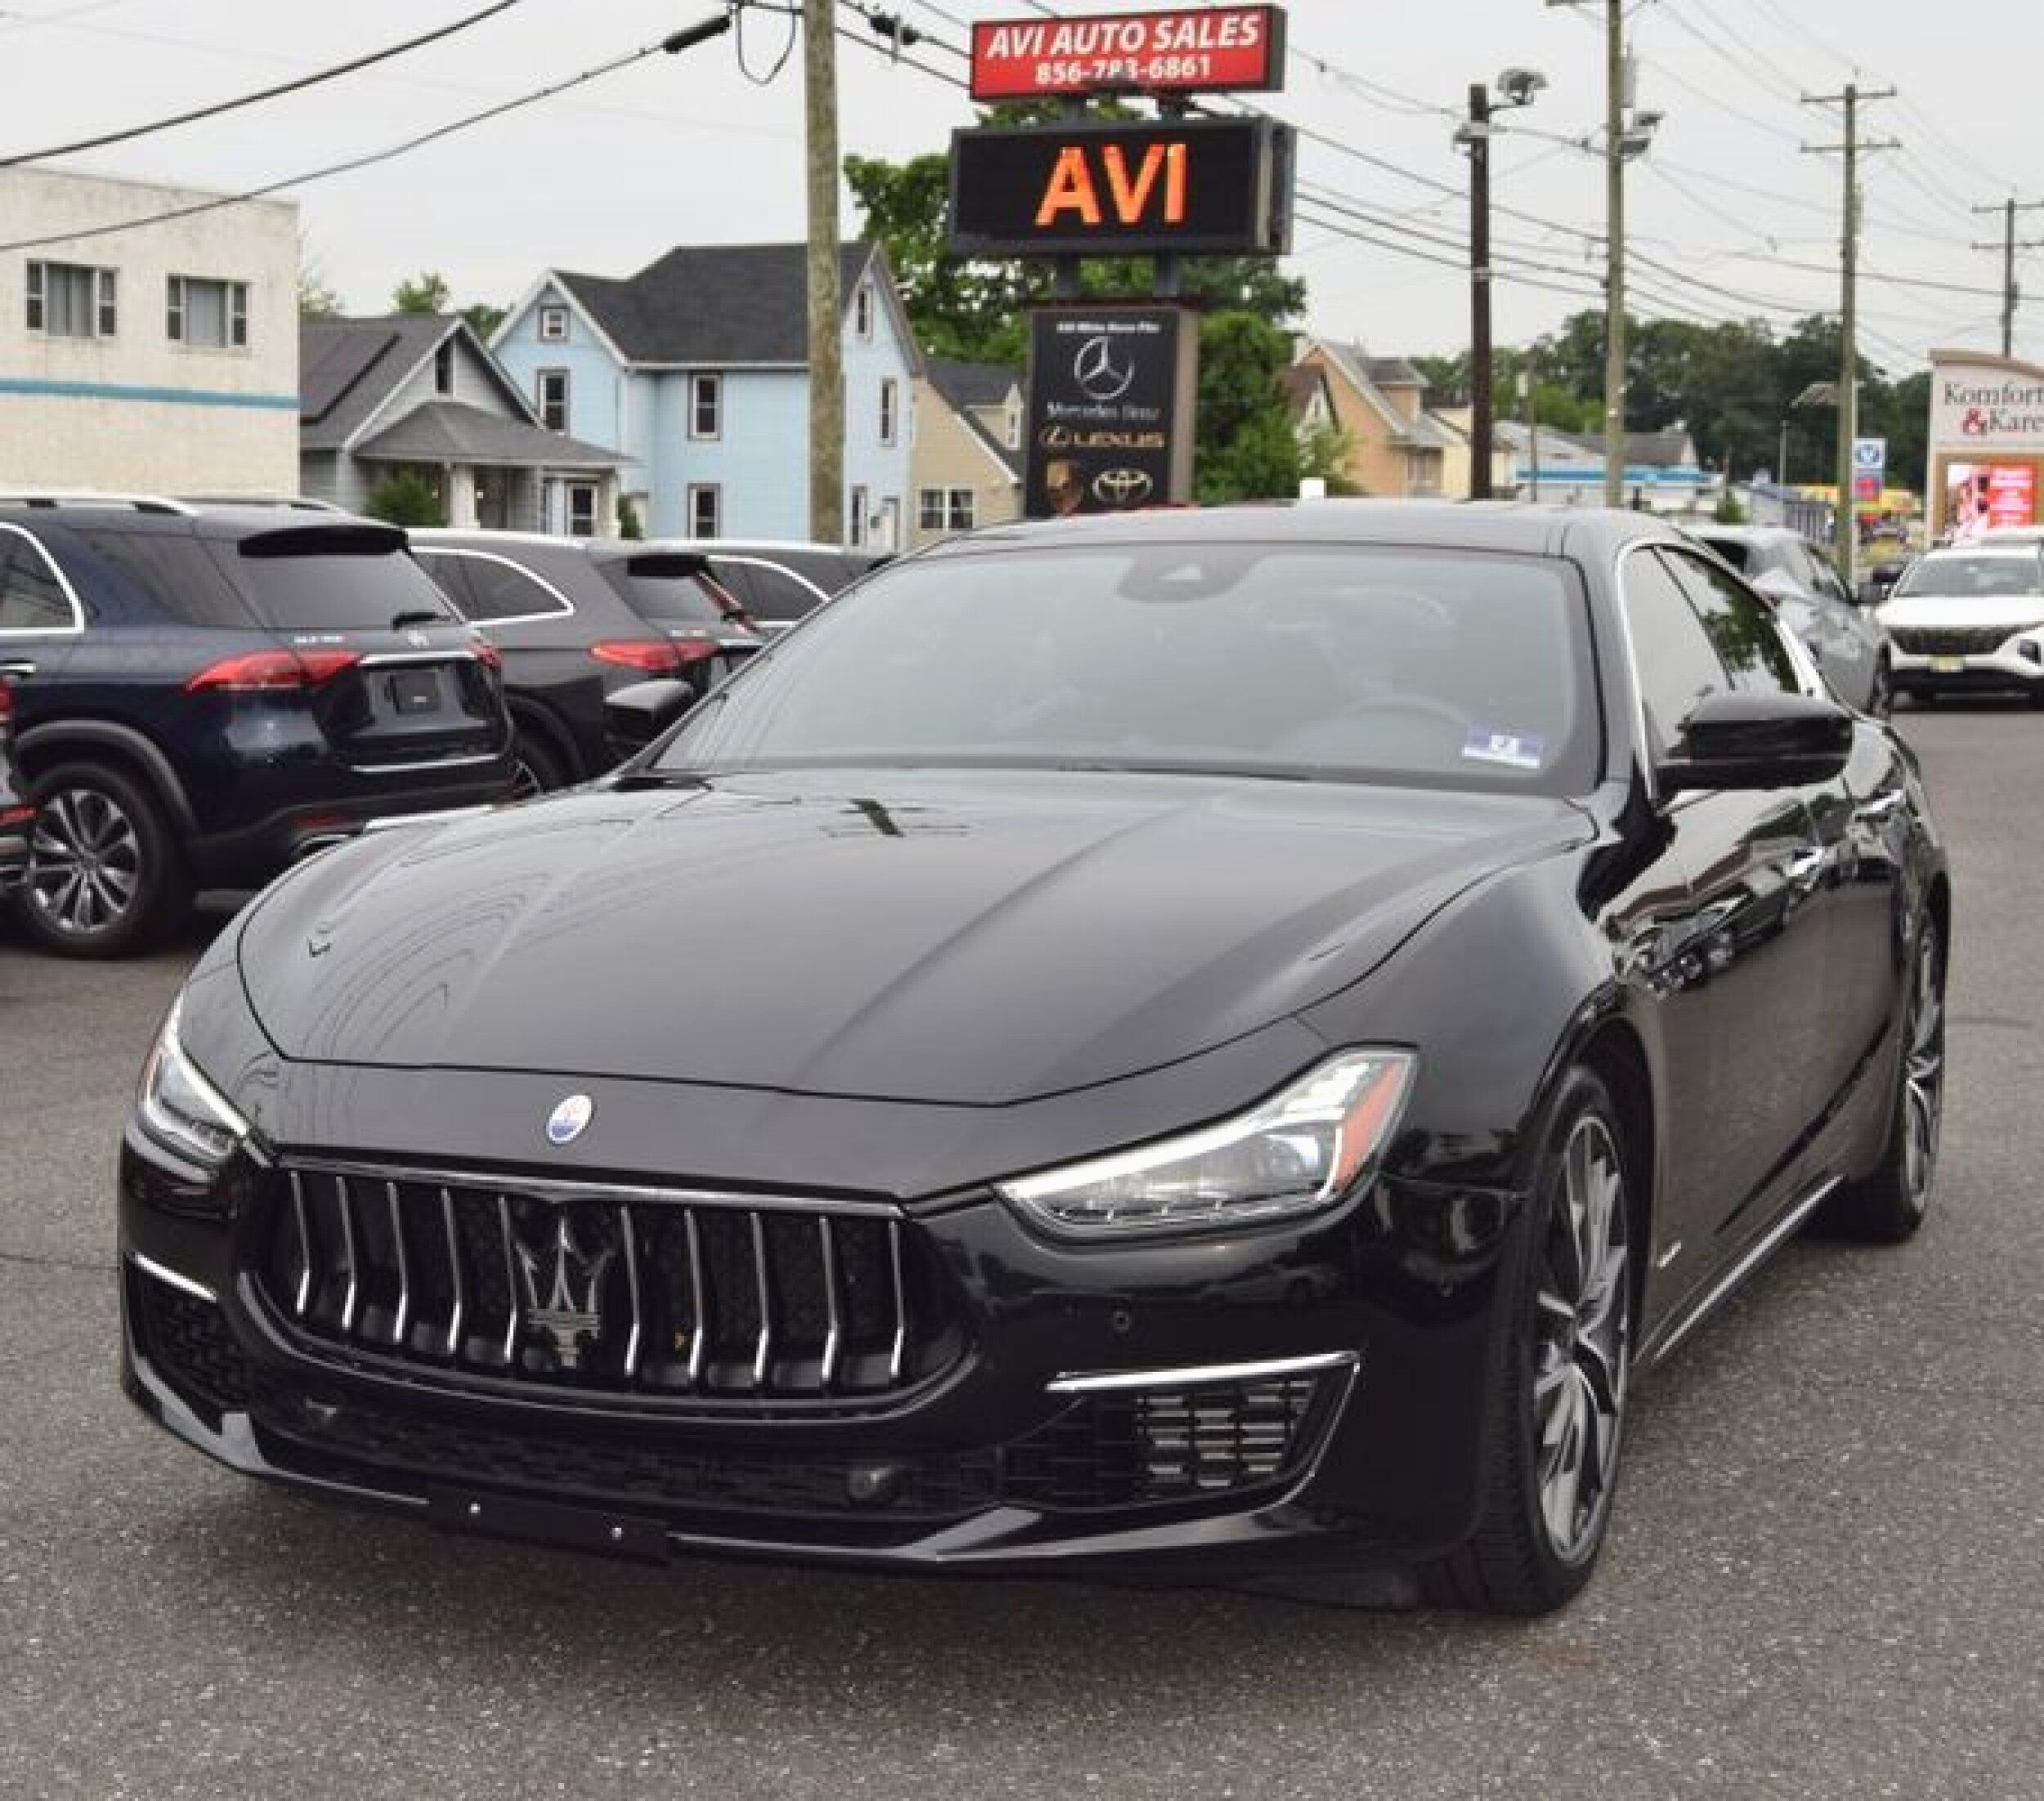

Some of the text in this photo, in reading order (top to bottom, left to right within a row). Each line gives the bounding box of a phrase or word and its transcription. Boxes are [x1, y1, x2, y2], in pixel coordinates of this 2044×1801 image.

[986, 14, 1262, 59] AVI AUTO SALES
[1034, 142, 1187, 226] AVI
[1943, 380, 2044, 405] Komfort
[1074, 431, 1166, 449] LEXUS
